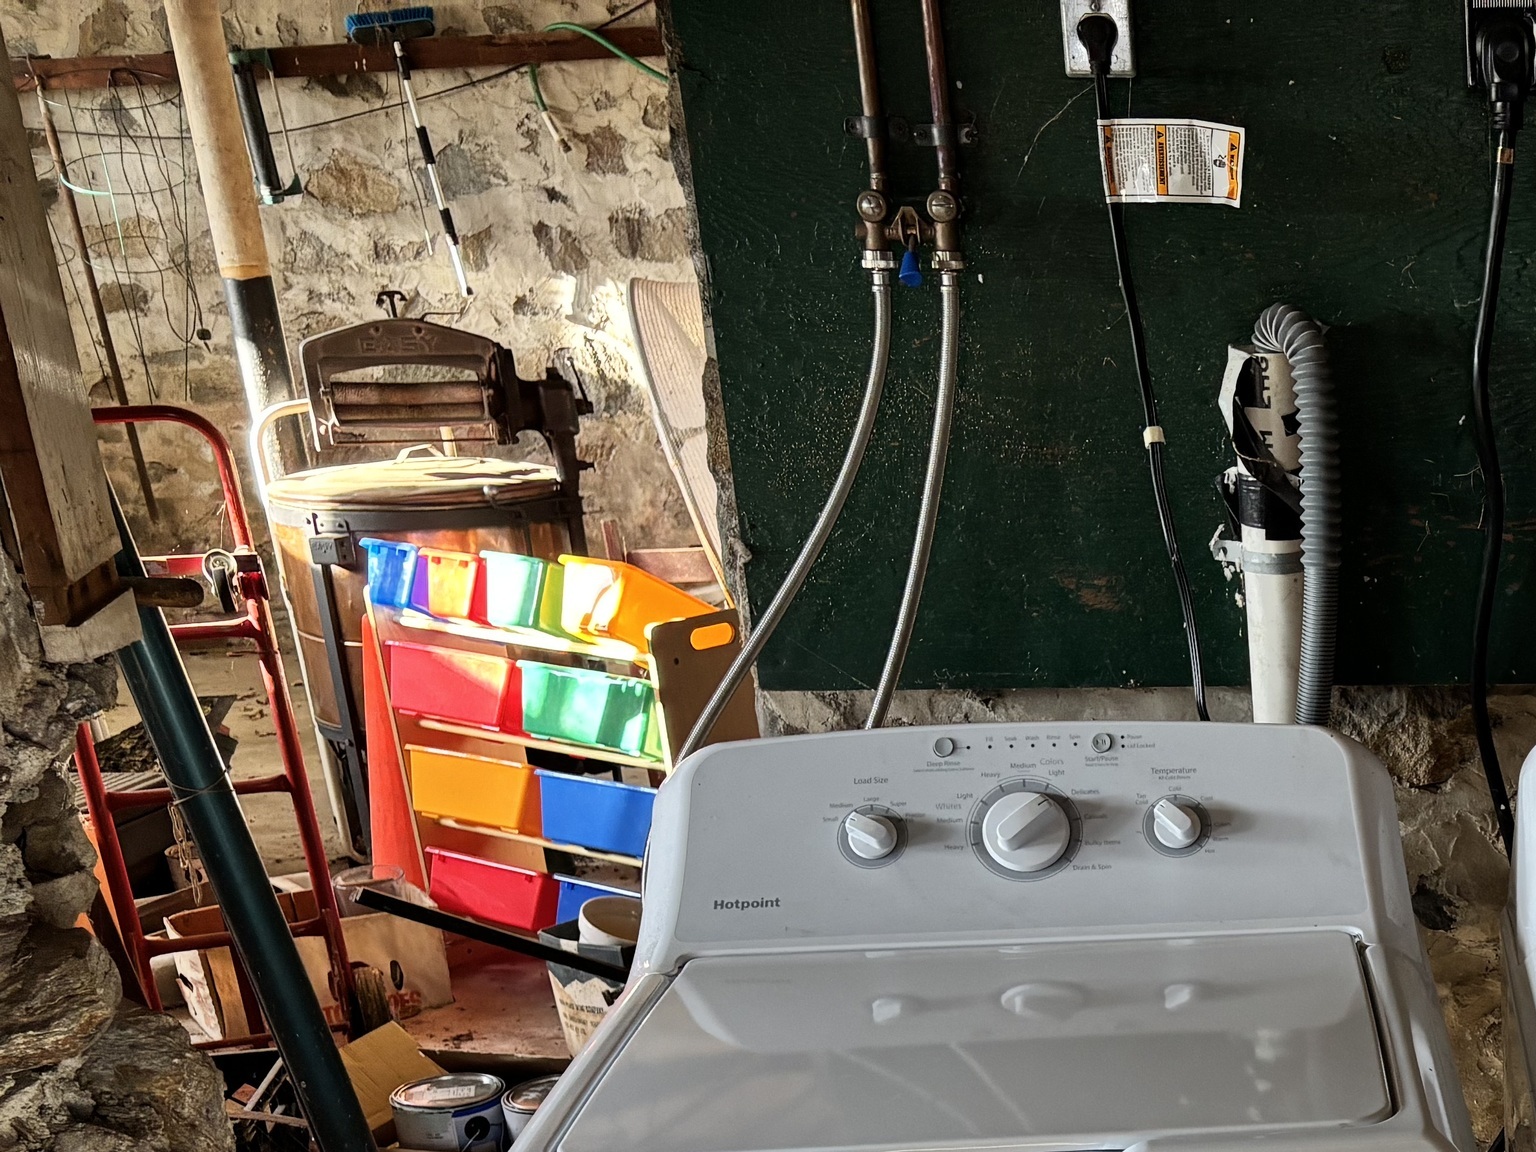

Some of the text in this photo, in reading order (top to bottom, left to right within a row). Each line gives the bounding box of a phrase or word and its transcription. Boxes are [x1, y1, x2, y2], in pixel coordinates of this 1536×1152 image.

[1039, 758, 1065, 766] Colors
[1084, 755, 1119, 763] Start/Pause
[1048, 769, 1065, 777] Light
[1151, 767, 1197, 776] Temperature
[853, 777, 872, 785] Load
[1070, 788, 1101, 796] Delicates
[956, 793, 973, 801] Light
[935, 802, 962, 811] Whites
[1098, 863, 1112, 871] Spin
[713, 897, 781, 911] Hotpoint
